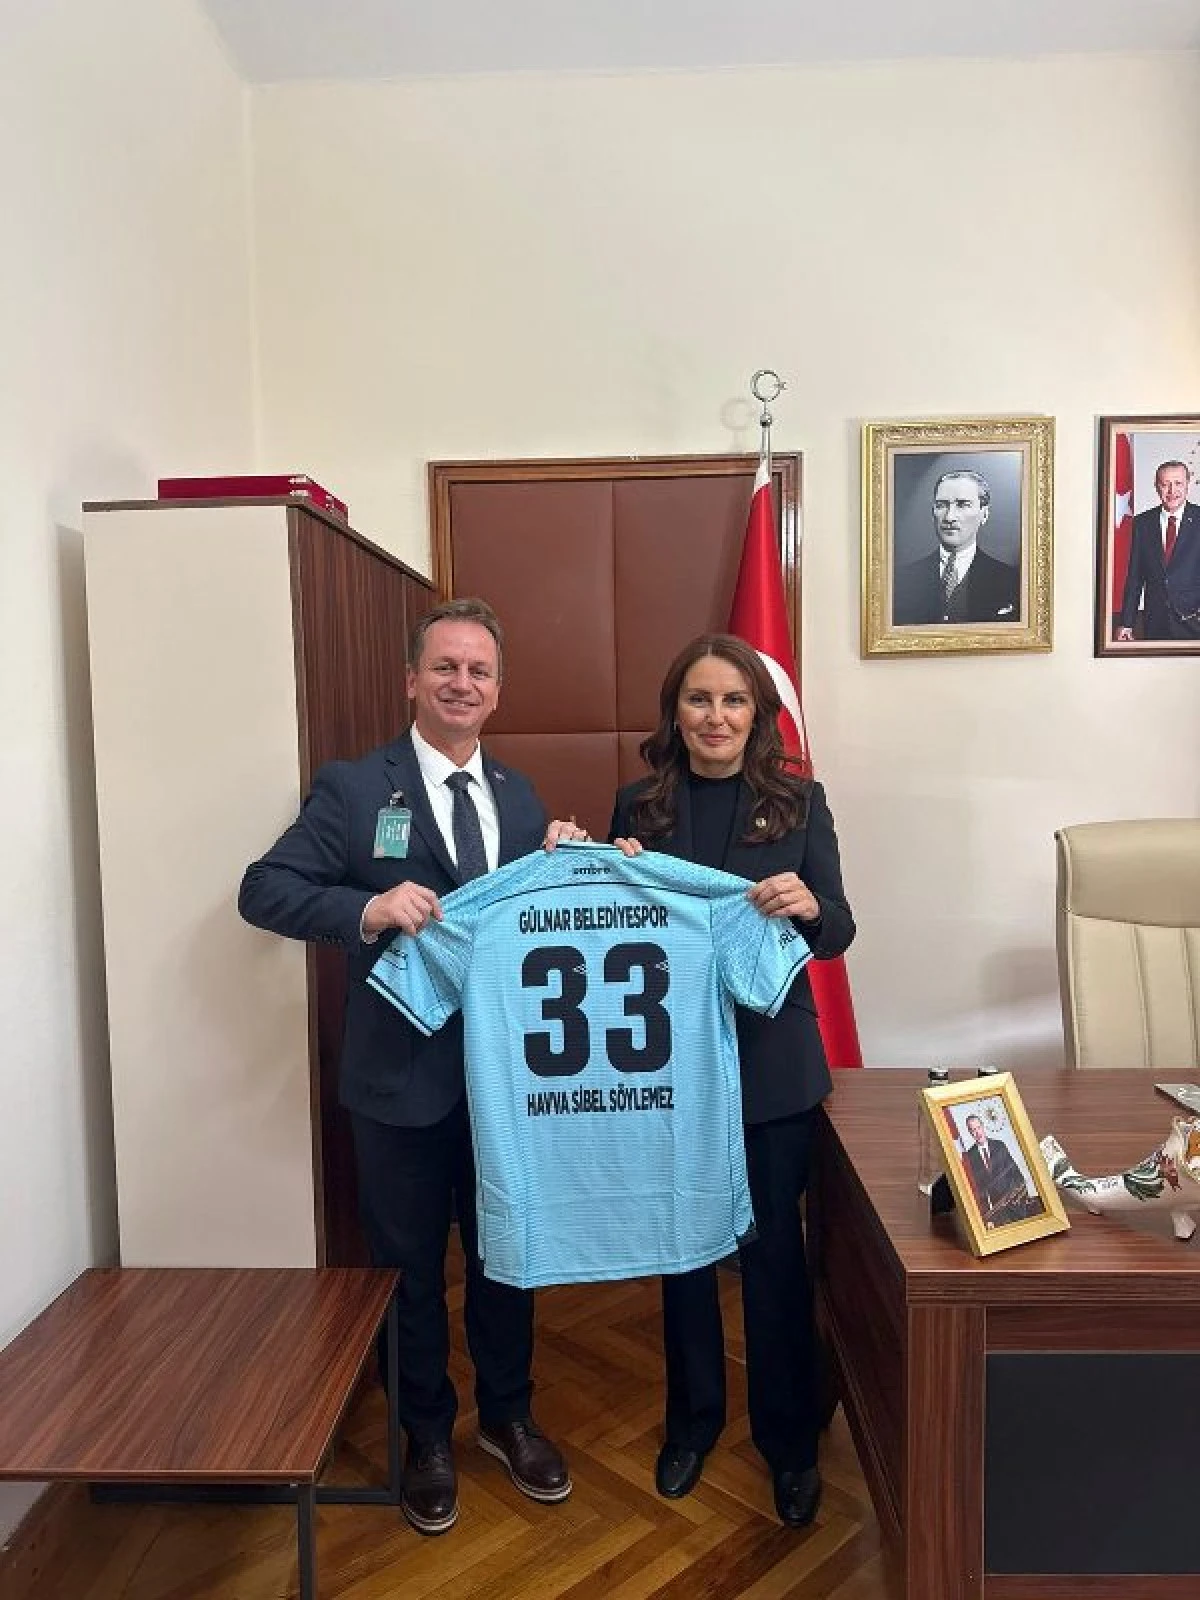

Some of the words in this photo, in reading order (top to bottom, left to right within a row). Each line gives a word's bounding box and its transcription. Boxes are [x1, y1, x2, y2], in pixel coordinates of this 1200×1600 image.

[519, 905, 571, 934] GÜLNAR
[573, 901, 669, 931] BELEDİYESPOR
[521, 941, 673, 1077] 33
[527, 1091, 569, 1117] HAVVA
[571, 1084, 607, 1113] SİBEL
[609, 1083, 675, 1112] SÖYLEMEZ
